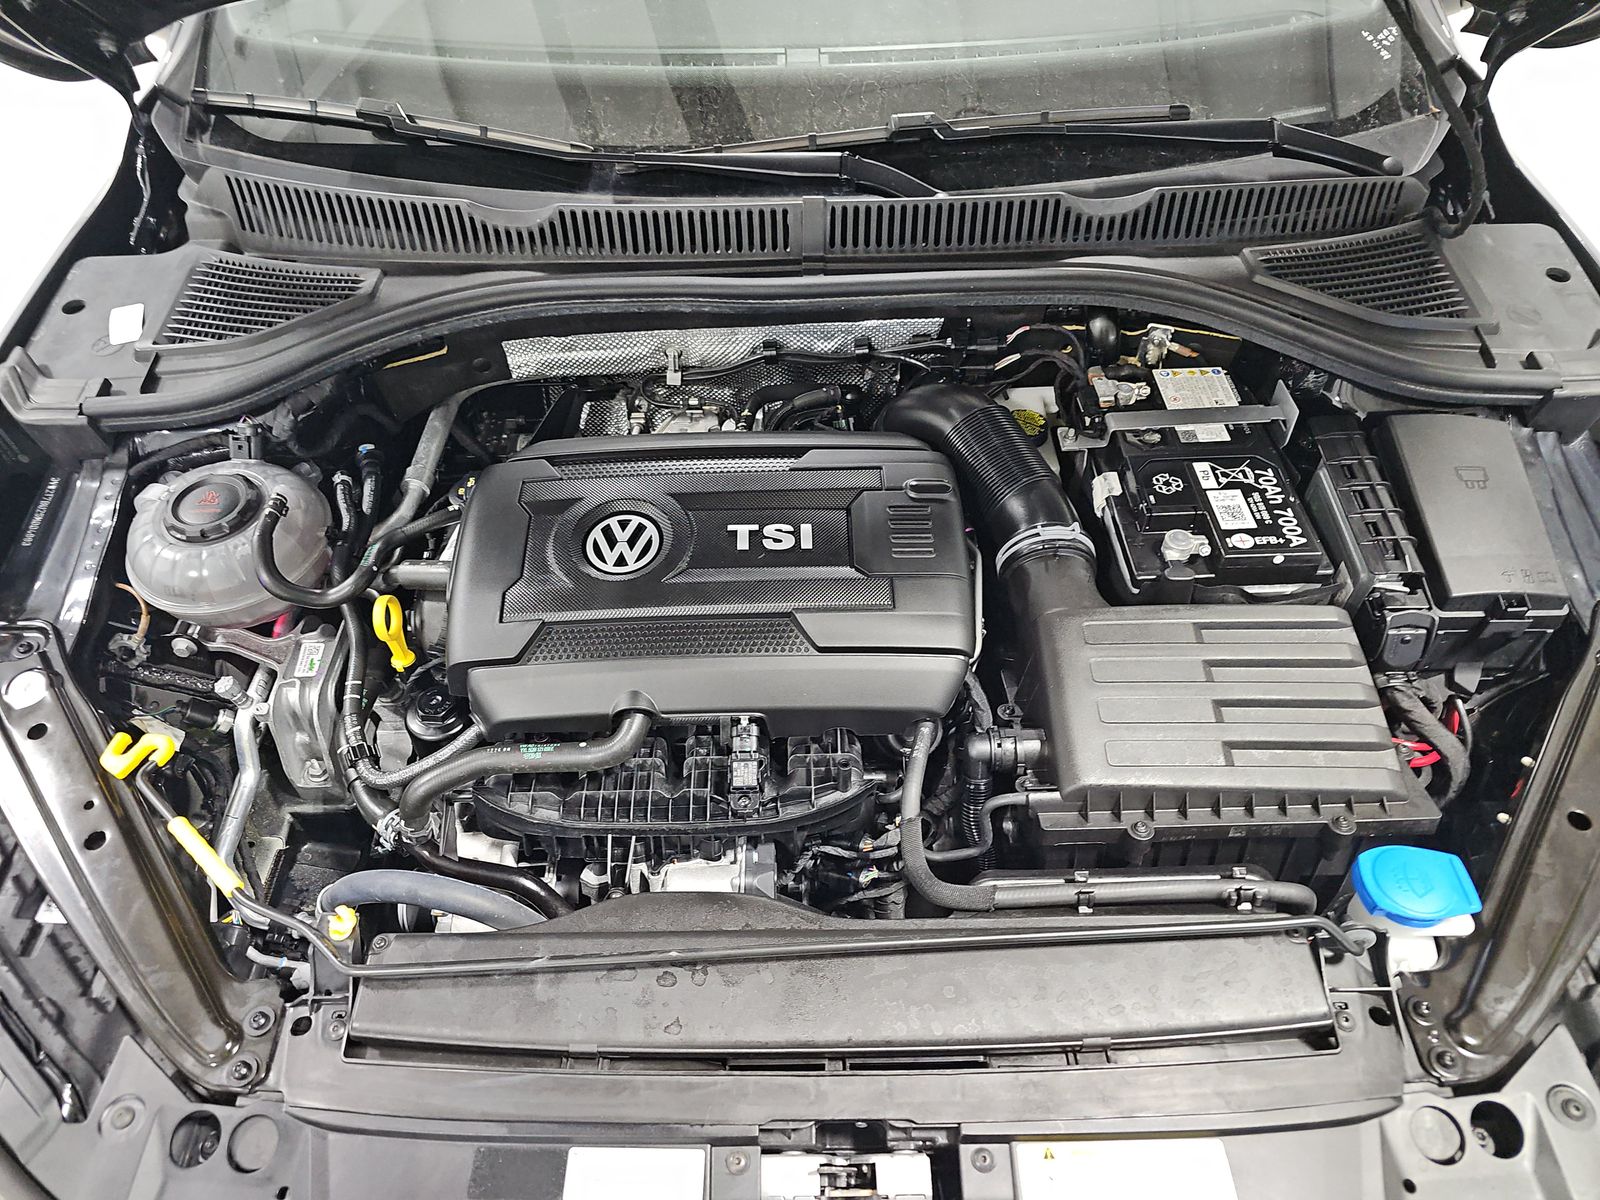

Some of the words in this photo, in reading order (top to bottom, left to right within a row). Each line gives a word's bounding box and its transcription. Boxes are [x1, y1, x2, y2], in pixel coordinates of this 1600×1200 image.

[1199, 469, 1211, 481] Pb
[1254, 468, 1286, 504] 70Ah
[1273, 507, 1308, 548] 700A
[586, 514, 660, 573] VW
[727, 523, 814, 551] TSI
[1254, 535, 1286, 545] EFB+
